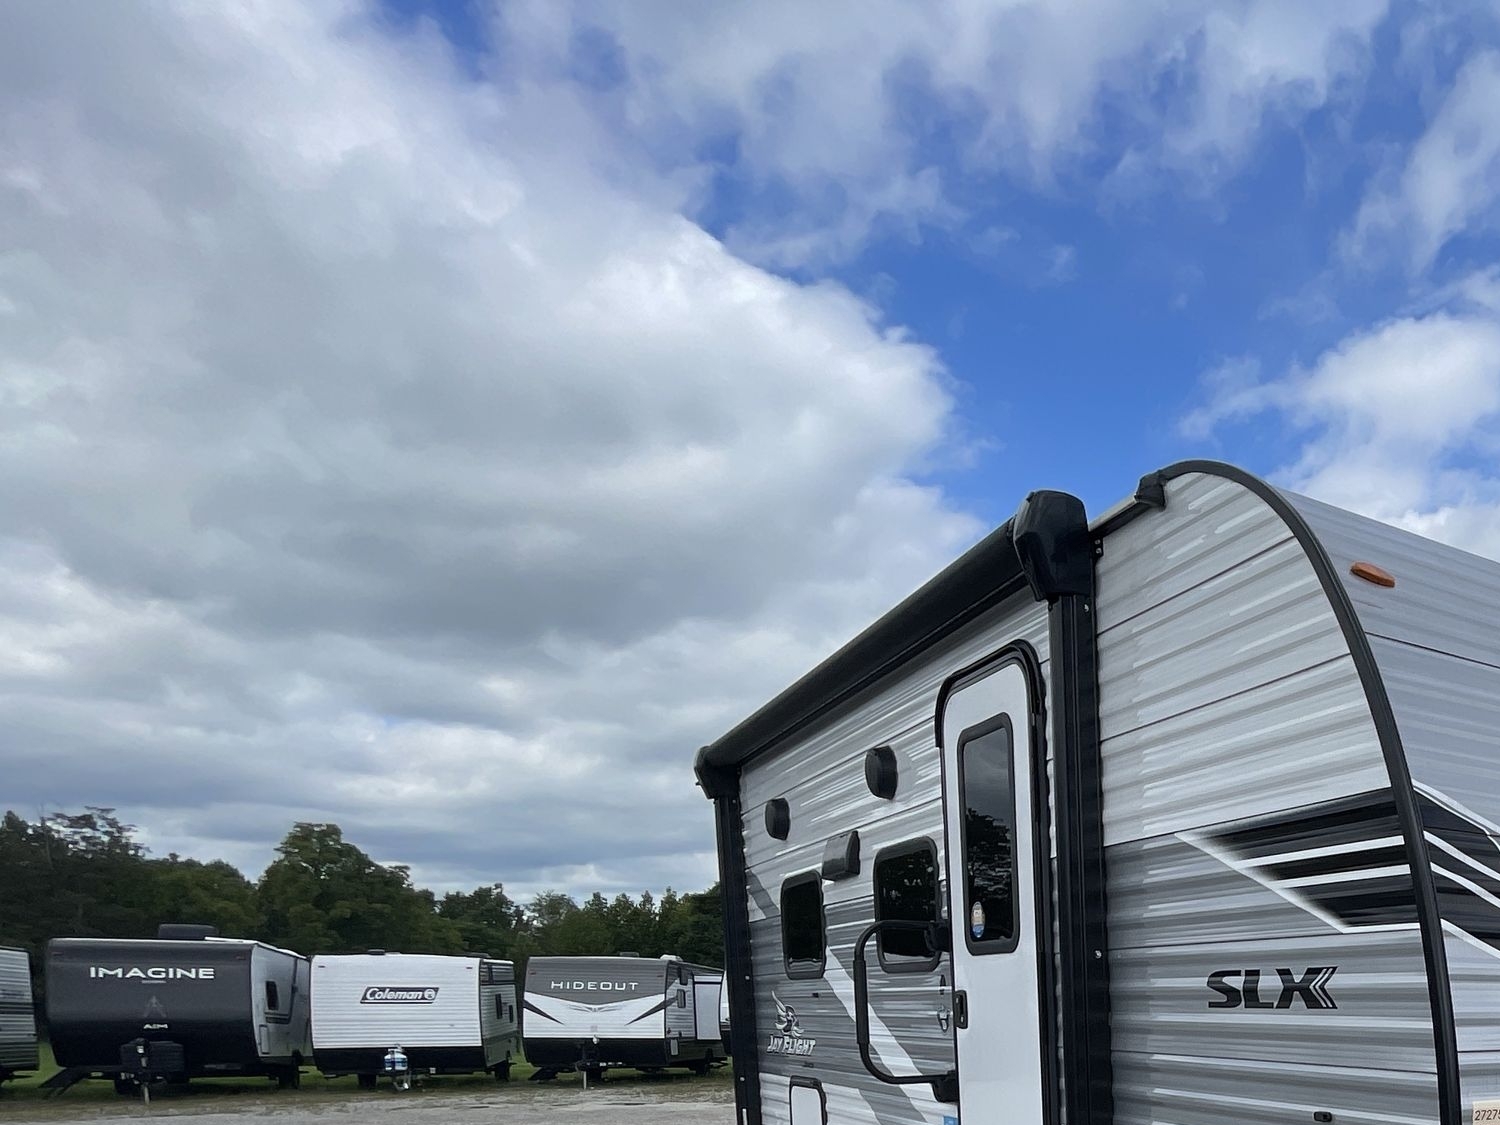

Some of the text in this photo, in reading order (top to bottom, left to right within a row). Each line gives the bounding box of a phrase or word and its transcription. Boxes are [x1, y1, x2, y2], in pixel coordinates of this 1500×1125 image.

[89, 966, 215, 979] IMAGINE
[550, 980, 640, 991] HIDEOUT
[1206, 966, 1338, 1009] SLX
[365, 987, 423, 1000] Coleman
[766, 1034, 816, 1056] JAY FLIGHT
